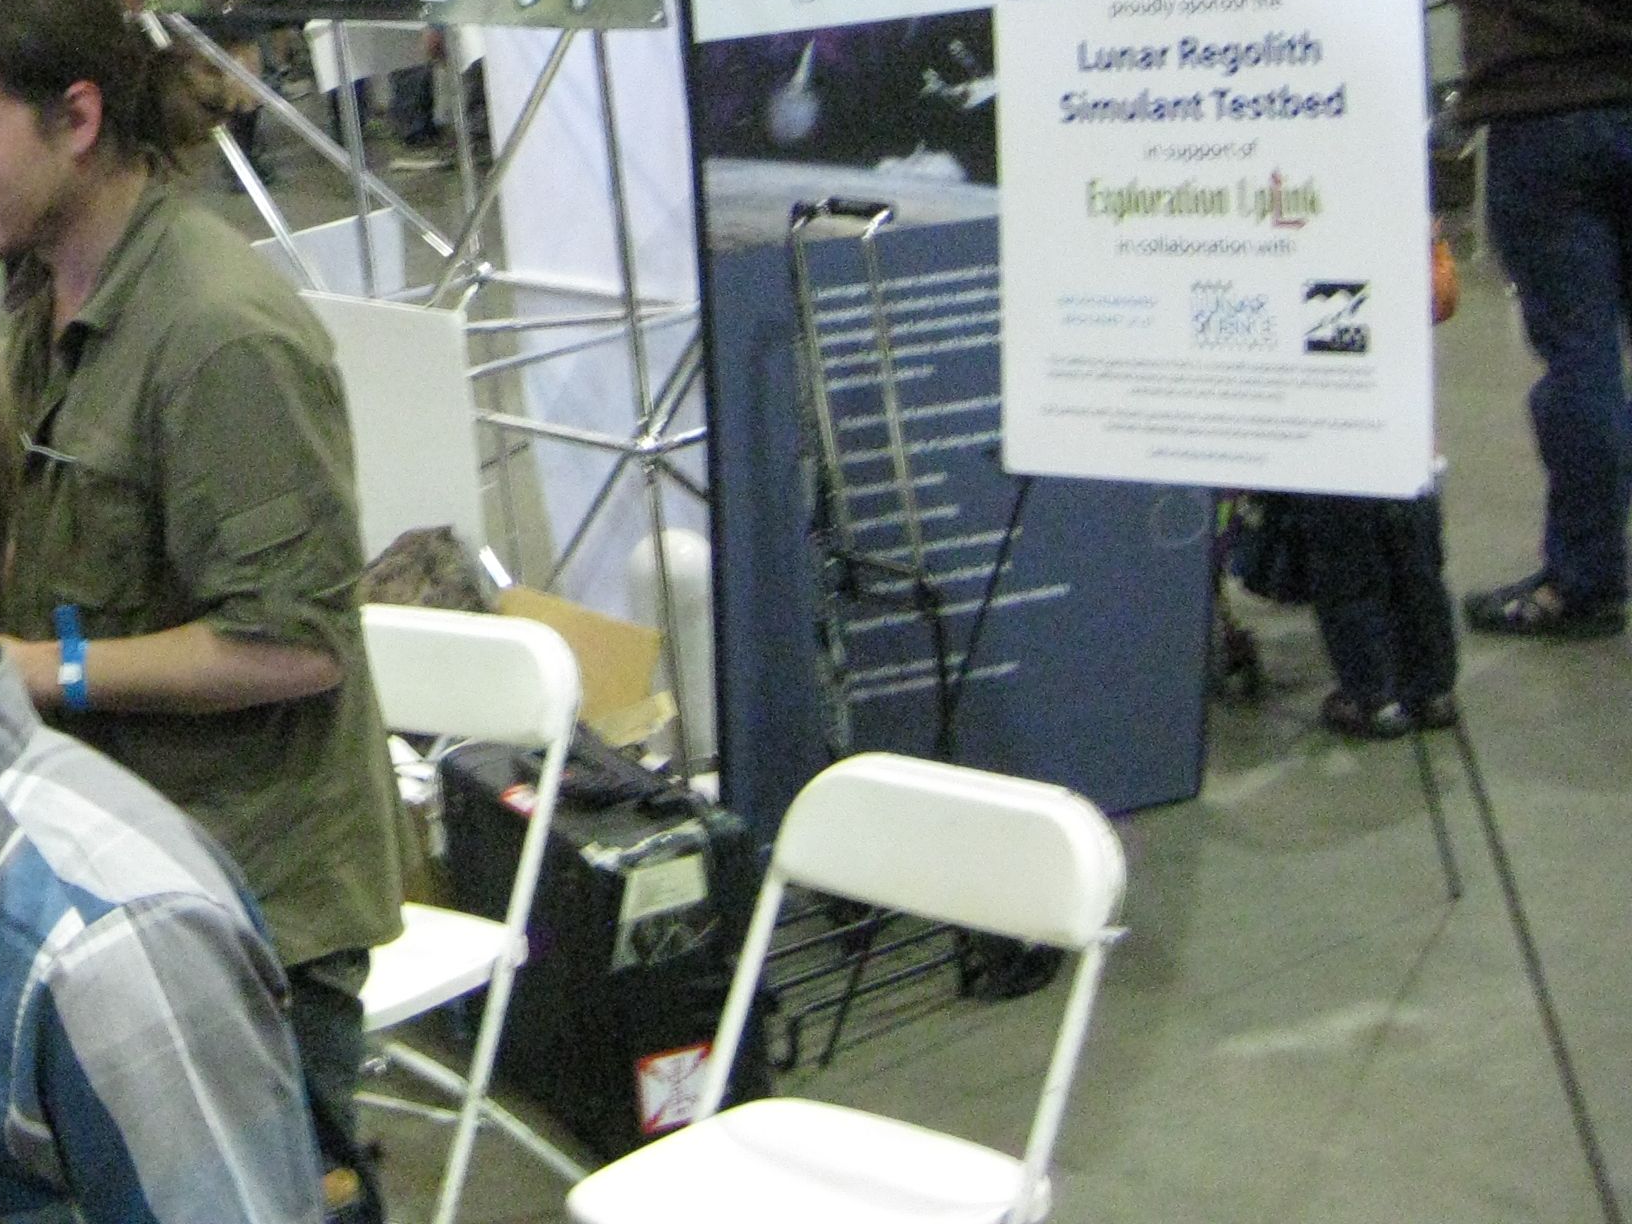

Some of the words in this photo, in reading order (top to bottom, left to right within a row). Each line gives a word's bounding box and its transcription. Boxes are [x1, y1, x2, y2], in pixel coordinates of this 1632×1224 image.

[1076, 39, 1171, 74] Lunar
[1176, 29, 1323, 77] Regolith
[1058, 87, 1203, 125] Simulant
[1209, 81, 1348, 123] Testbed
